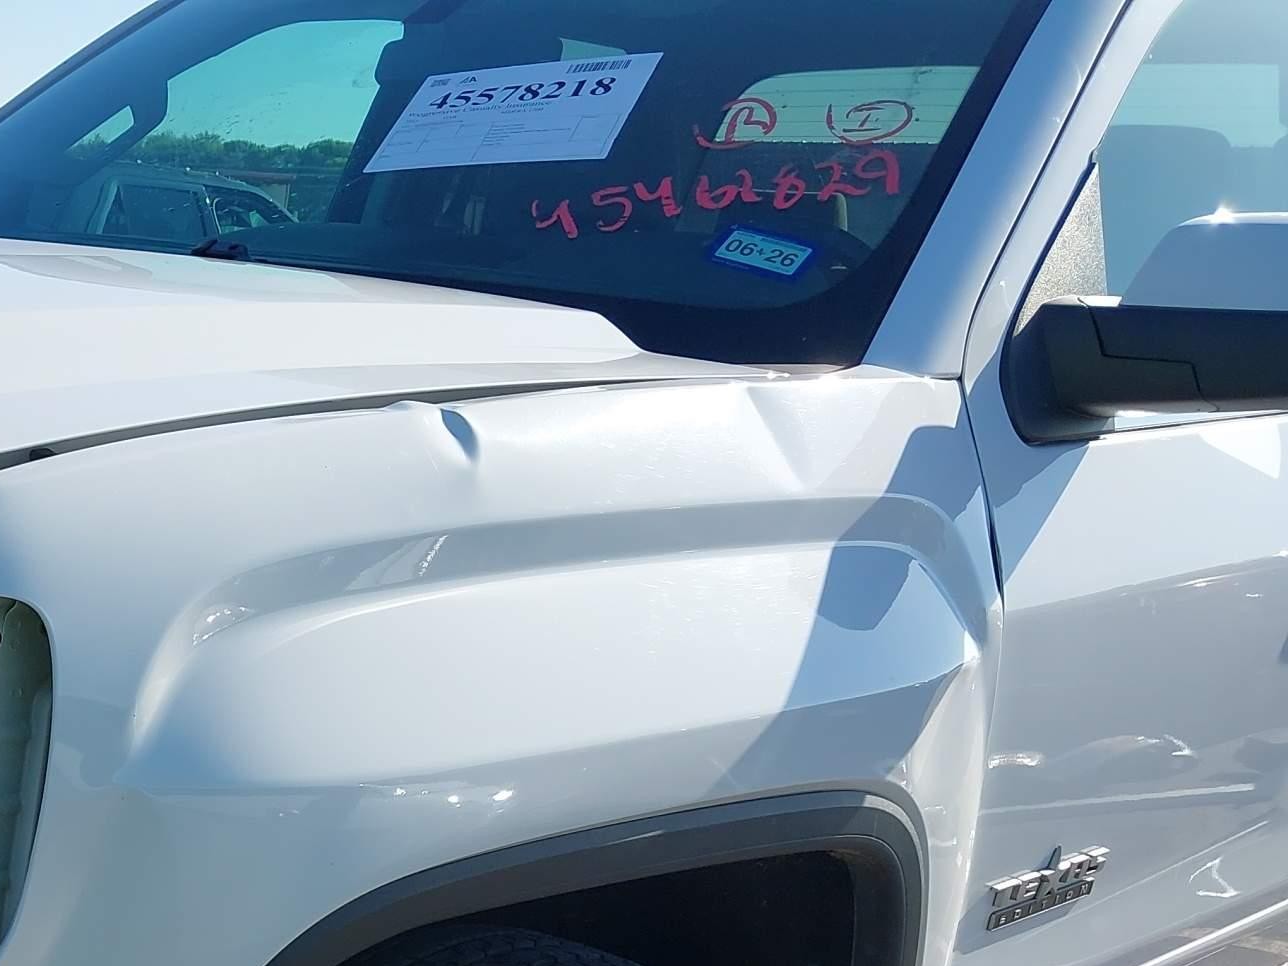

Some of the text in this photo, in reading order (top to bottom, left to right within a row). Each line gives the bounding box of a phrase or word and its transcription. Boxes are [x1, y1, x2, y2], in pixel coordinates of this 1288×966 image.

[429, 76, 616, 110] 45578218
[985, 845, 1111, 907] TEXAS
[998, 882, 1091, 926] EDITION
